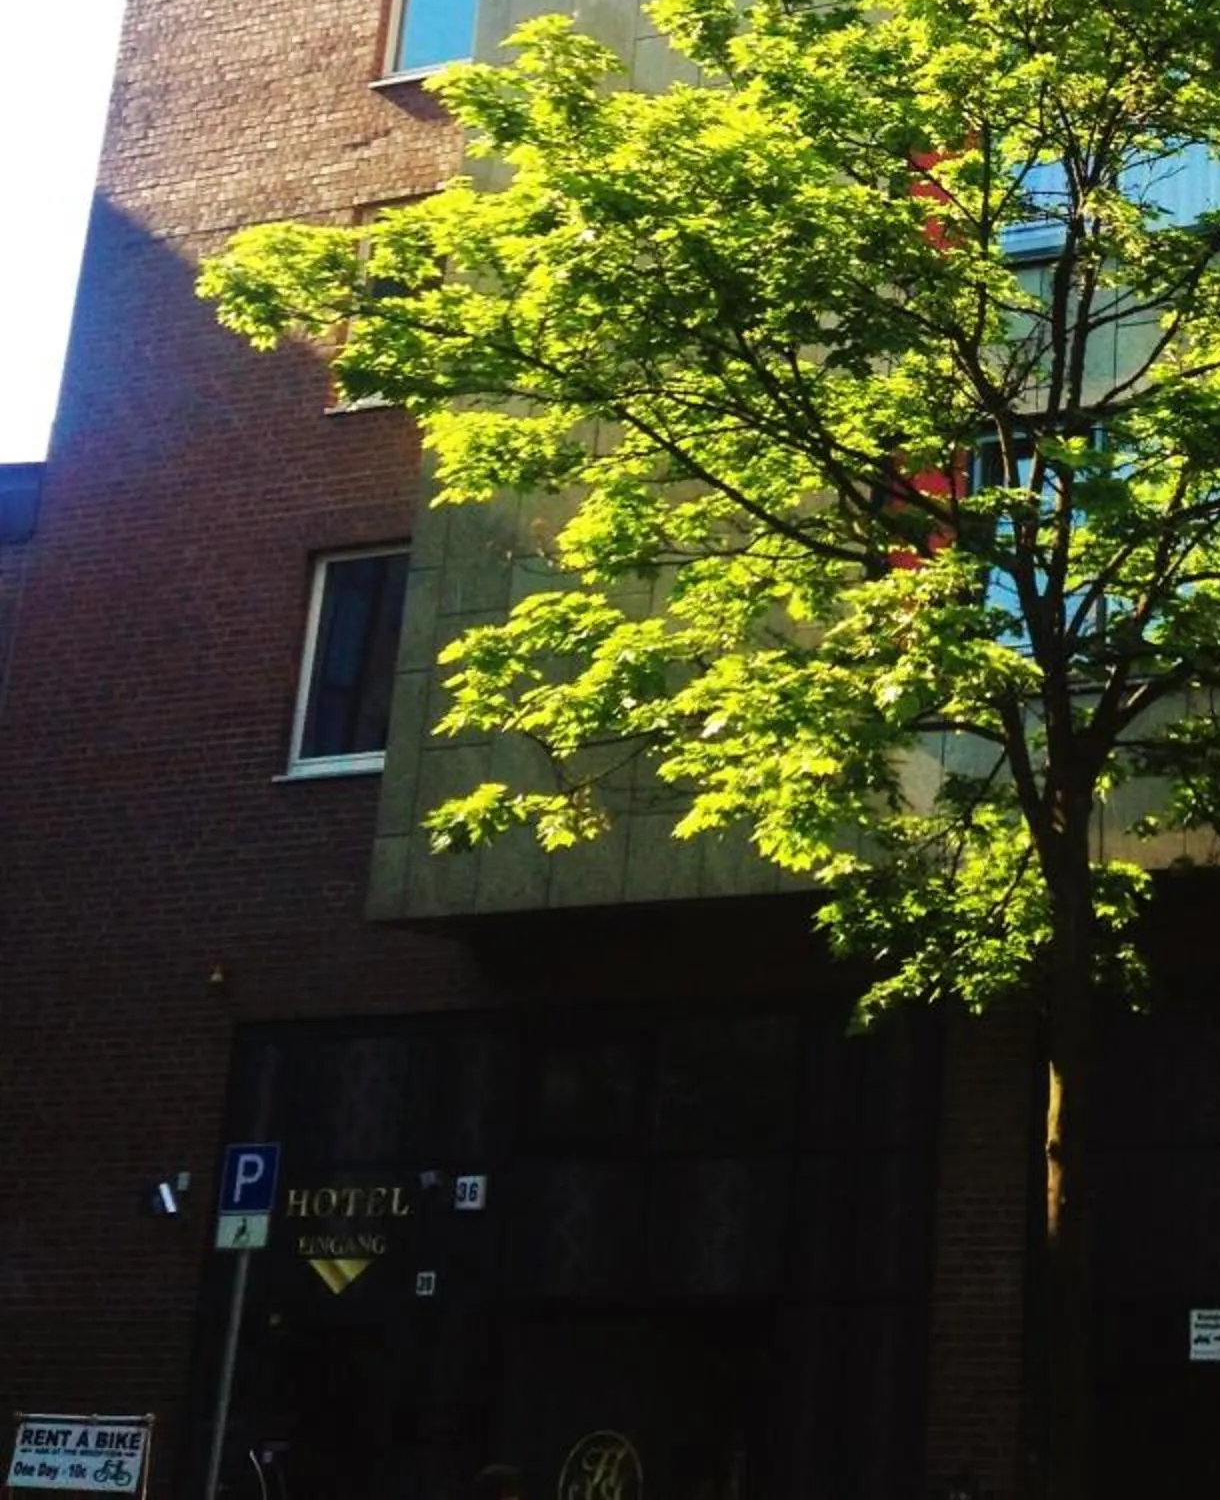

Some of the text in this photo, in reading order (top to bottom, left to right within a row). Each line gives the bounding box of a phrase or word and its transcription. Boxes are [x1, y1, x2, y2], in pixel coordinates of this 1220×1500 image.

[231, 1152, 266, 1205] P
[285, 1186, 412, 1218] HOTEL
[457, 1182, 479, 1202] 36
[20, 1429, 141, 1450] RENT A BIKE
